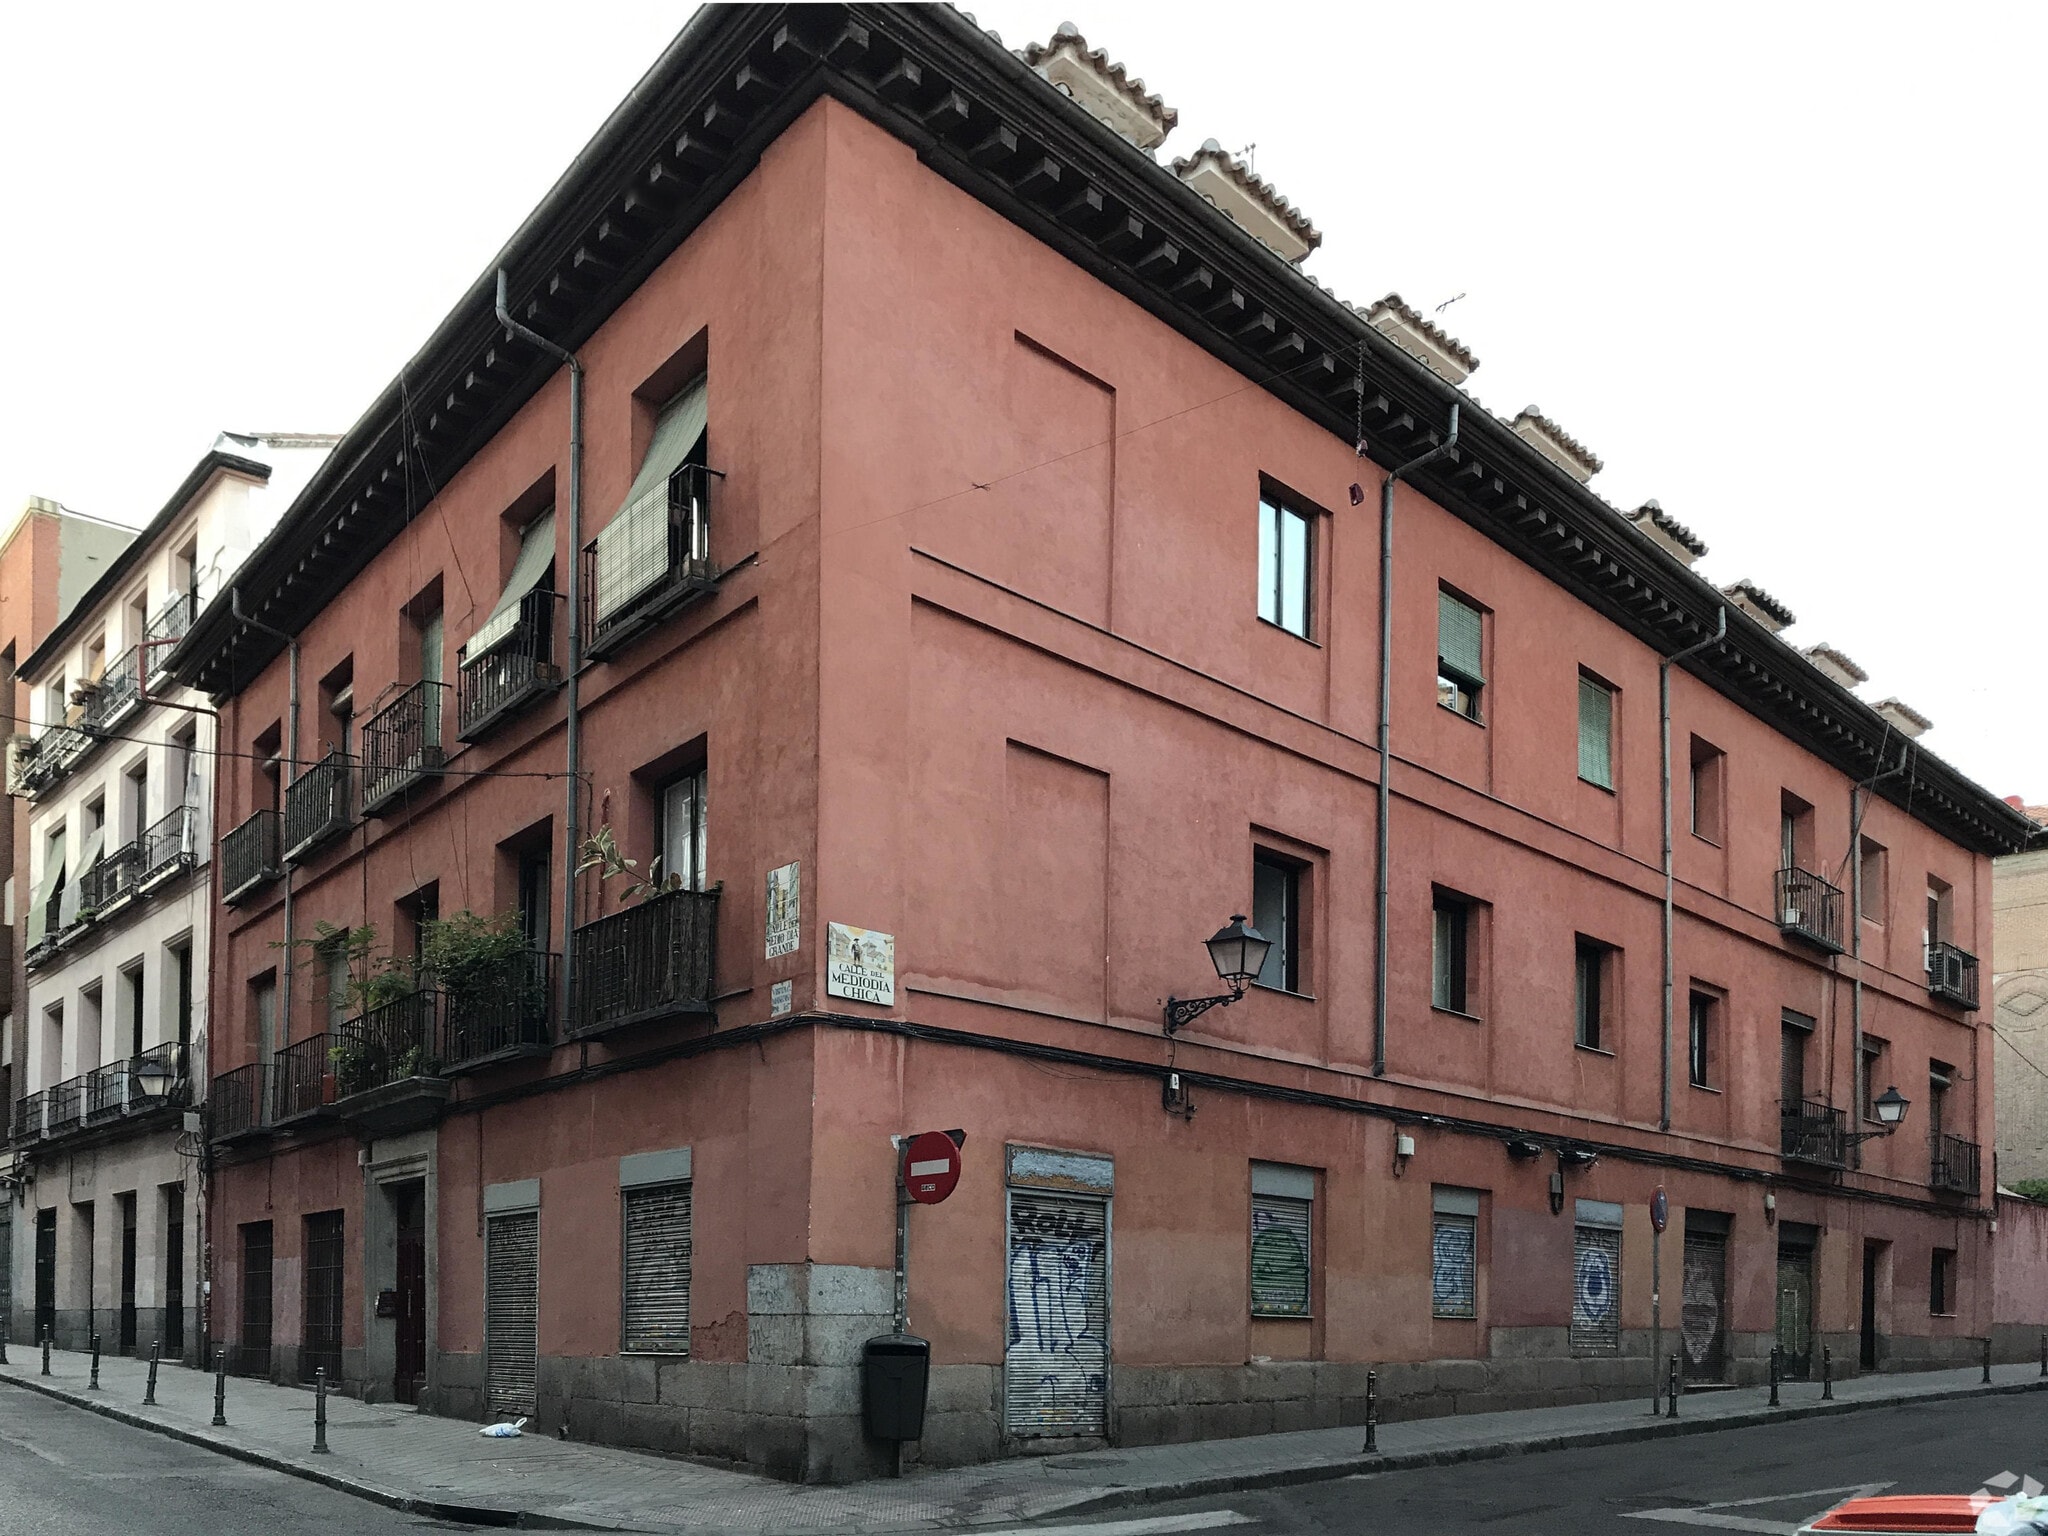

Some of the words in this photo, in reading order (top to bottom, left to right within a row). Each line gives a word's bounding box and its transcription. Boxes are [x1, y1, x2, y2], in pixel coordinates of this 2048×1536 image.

[769, 940, 795, 957] GRANDE
[839, 963, 868, 977] CALLE
[870, 970, 885, 979] DEL
[832, 971, 892, 993] MEDIODIA
[843, 985, 880, 1002] CHICA
